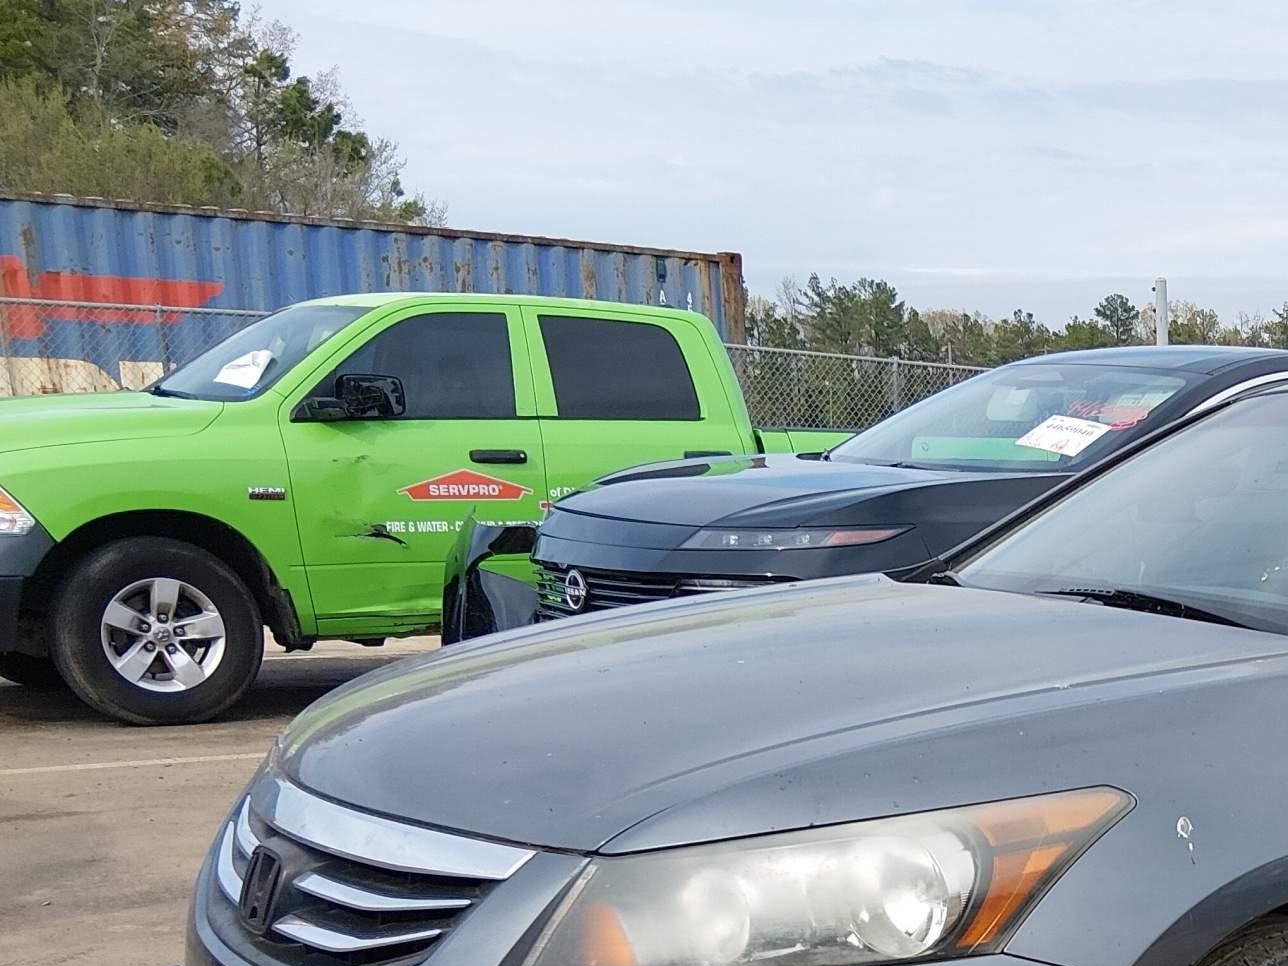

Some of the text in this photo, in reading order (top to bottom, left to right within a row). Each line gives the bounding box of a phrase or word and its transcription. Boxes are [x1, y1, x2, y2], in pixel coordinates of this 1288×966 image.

[429, 484, 500, 496] SERVPRO
[386, 521, 405, 533] FIRE
[408, 521, 415, 532] &
[416, 520, 448, 533] WATER
